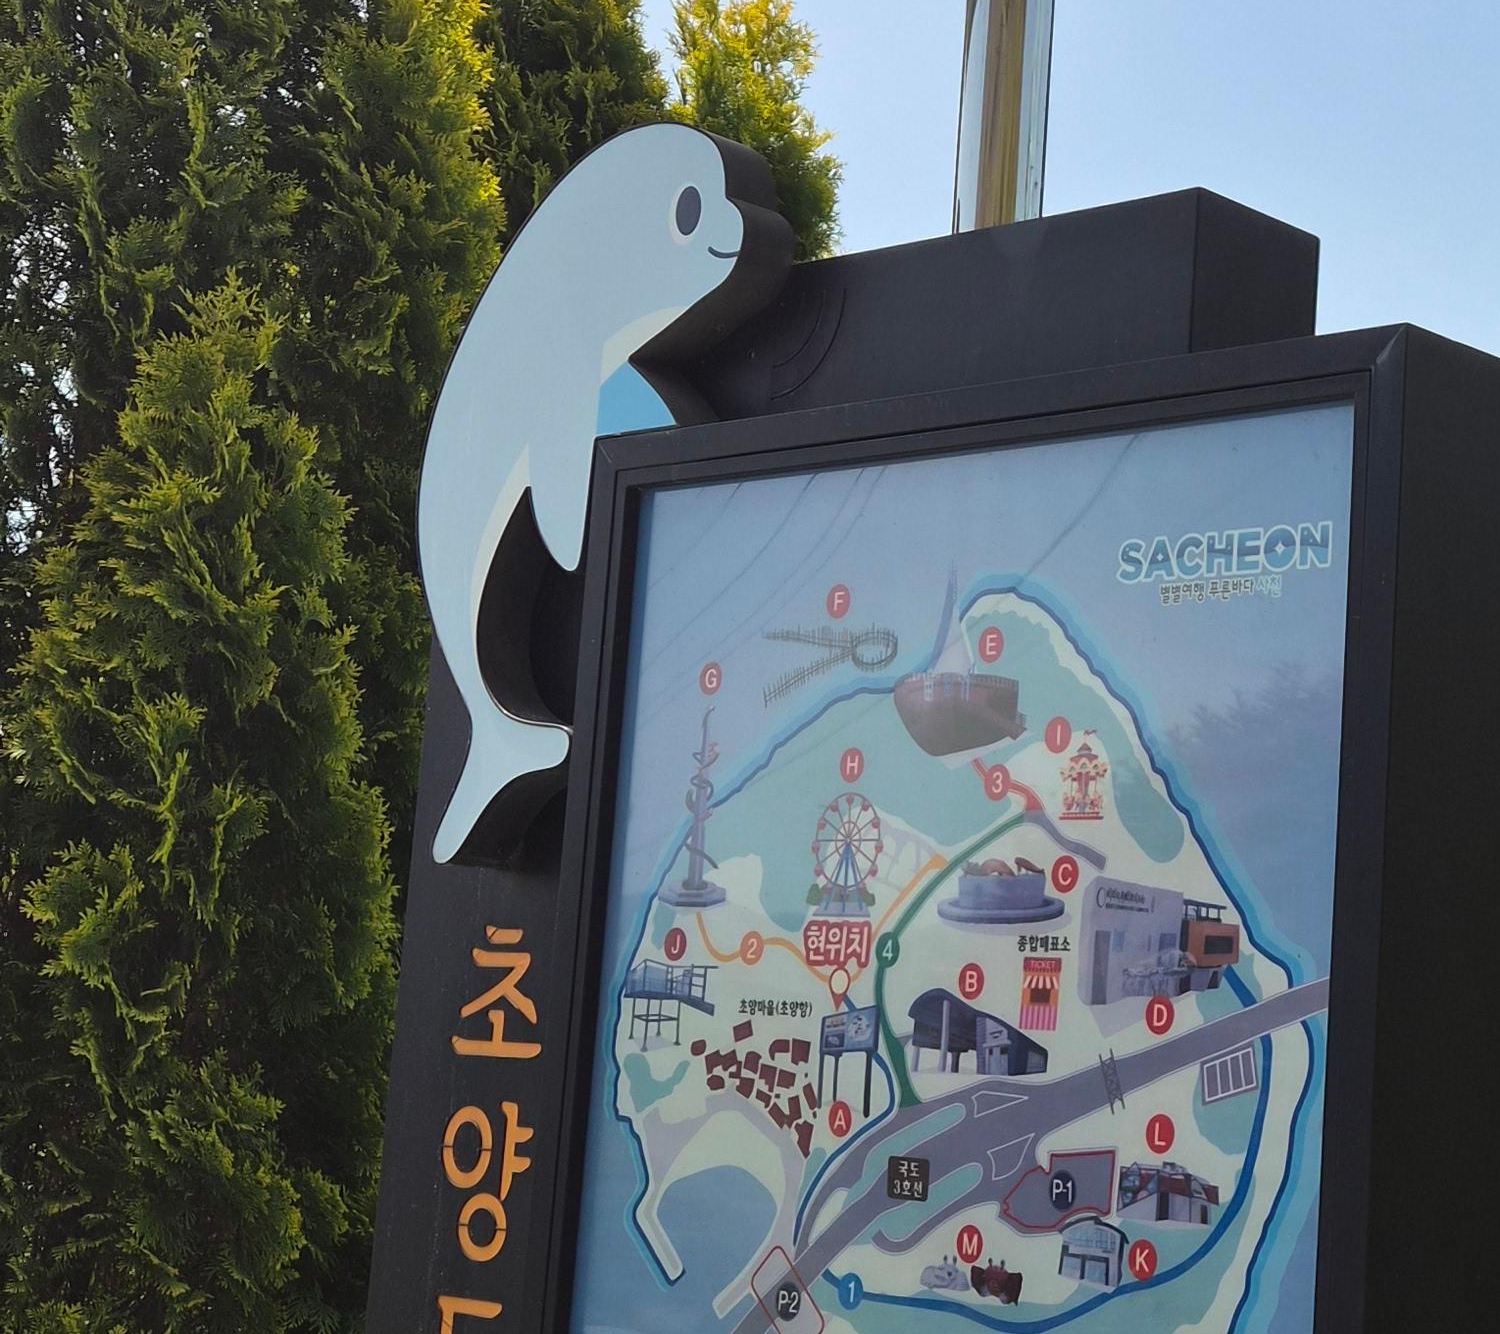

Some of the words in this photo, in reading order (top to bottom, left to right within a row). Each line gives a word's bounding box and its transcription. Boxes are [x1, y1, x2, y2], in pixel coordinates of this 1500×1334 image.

[1117, 521, 1333, 584] SACHEON
[807, 924, 869, 963] 현위치
[898, 1160, 920, 1177] 국도
[893, 1179, 922, 1198] 3호선
